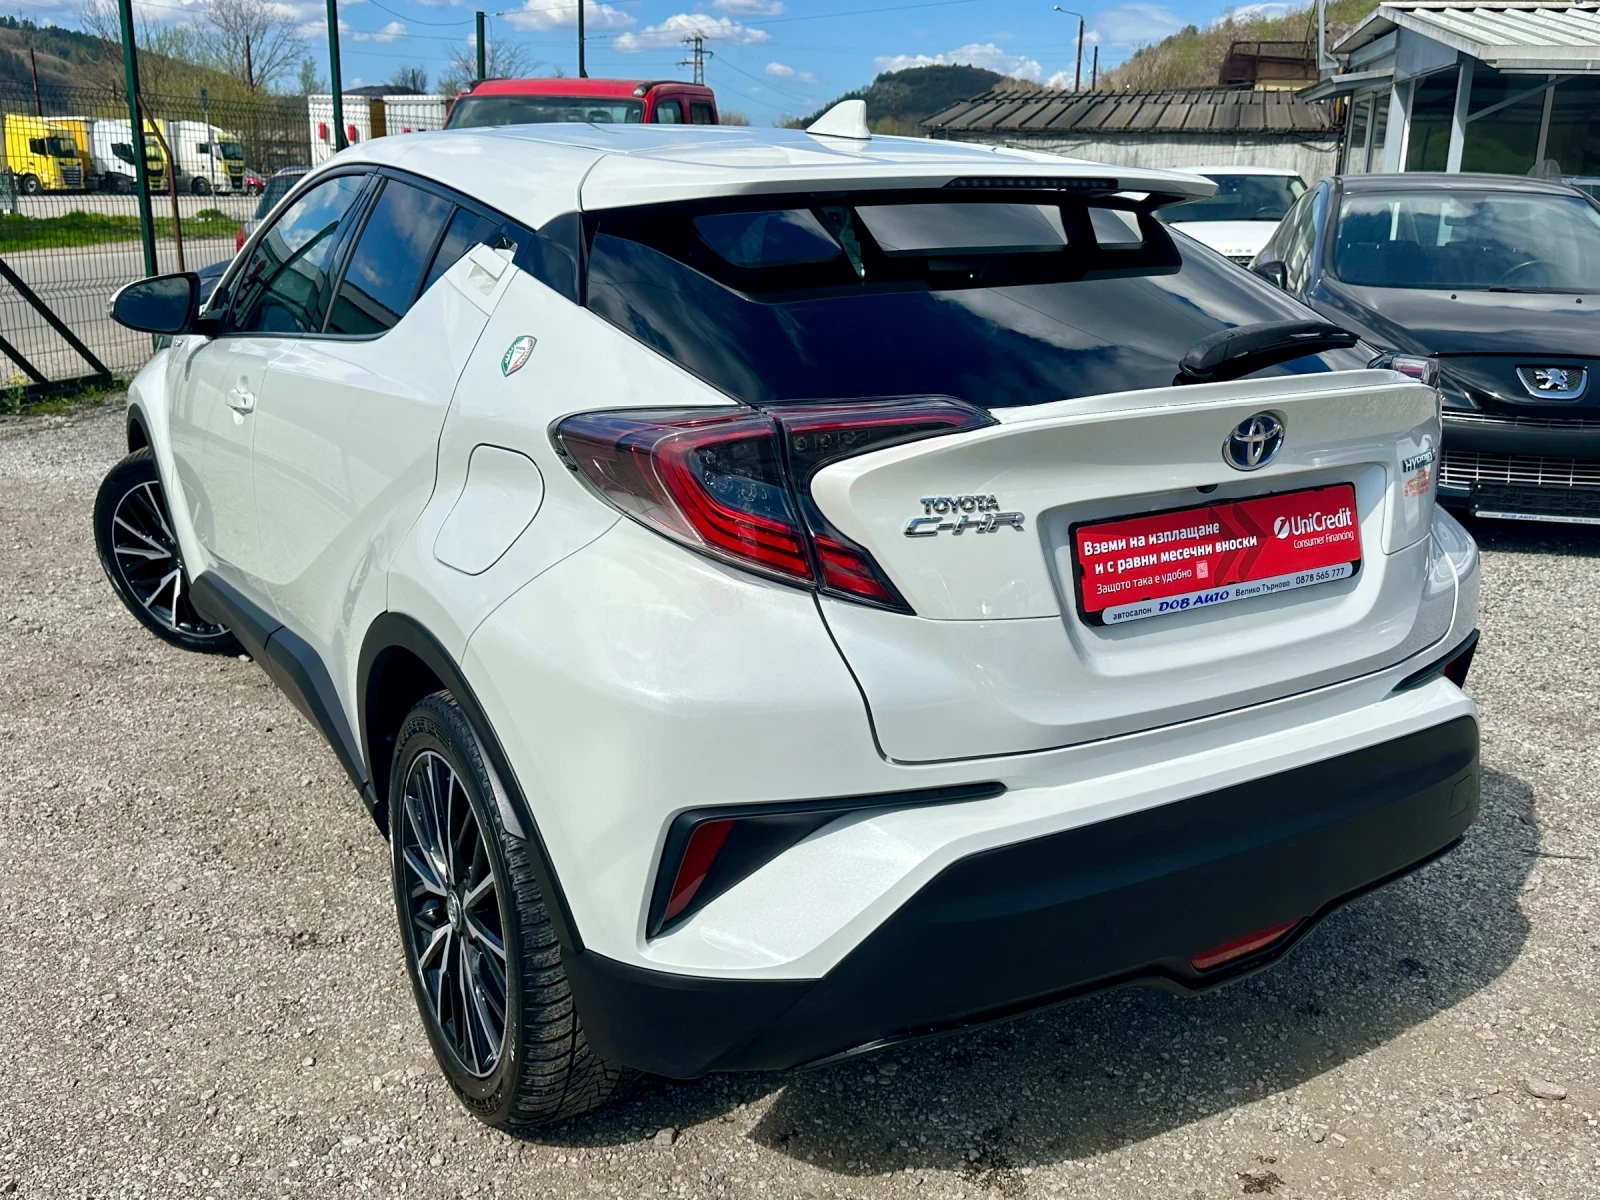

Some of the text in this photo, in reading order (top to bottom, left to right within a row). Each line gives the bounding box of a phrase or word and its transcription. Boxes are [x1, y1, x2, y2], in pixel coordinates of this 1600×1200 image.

[920, 495, 1000, 515] TOYOTA
[904, 511, 1025, 538] C-HR
[1291, 507, 1352, 535] UniCredit
[1084, 523, 1220, 556] Вземи на изплащане
[1294, 530, 1354, 549] Consumer Financing
[1095, 536, 1257, 574] и с равни месечни вноски
[1097, 568, 1192, 595] Защото така е удобно
[1112, 567, 1345, 621] автосалон DOB AUTO Велико Търново 0878 565 777
